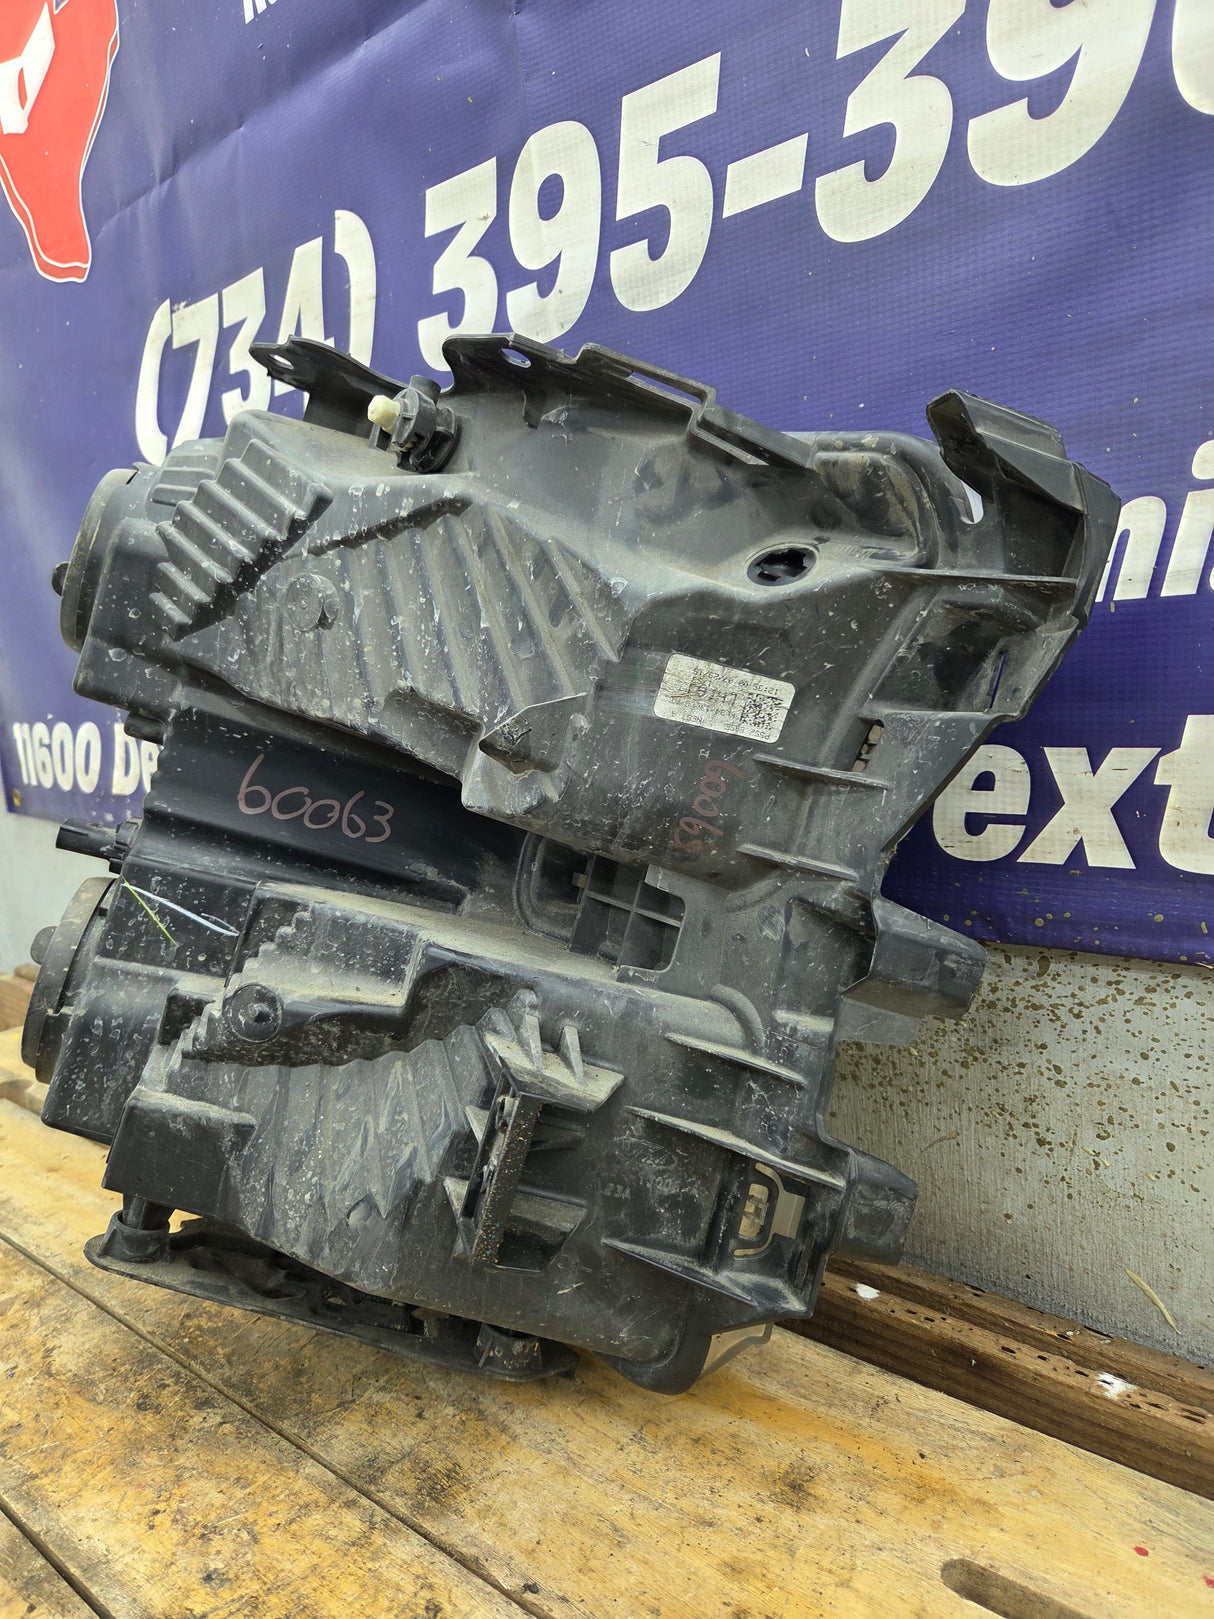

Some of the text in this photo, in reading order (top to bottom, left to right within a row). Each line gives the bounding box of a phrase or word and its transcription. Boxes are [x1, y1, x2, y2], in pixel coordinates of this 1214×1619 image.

[418, 0, 1214, 373] 395-39
[13, 721, 101, 794] 11600
[238, 754, 394, 843] 60063
